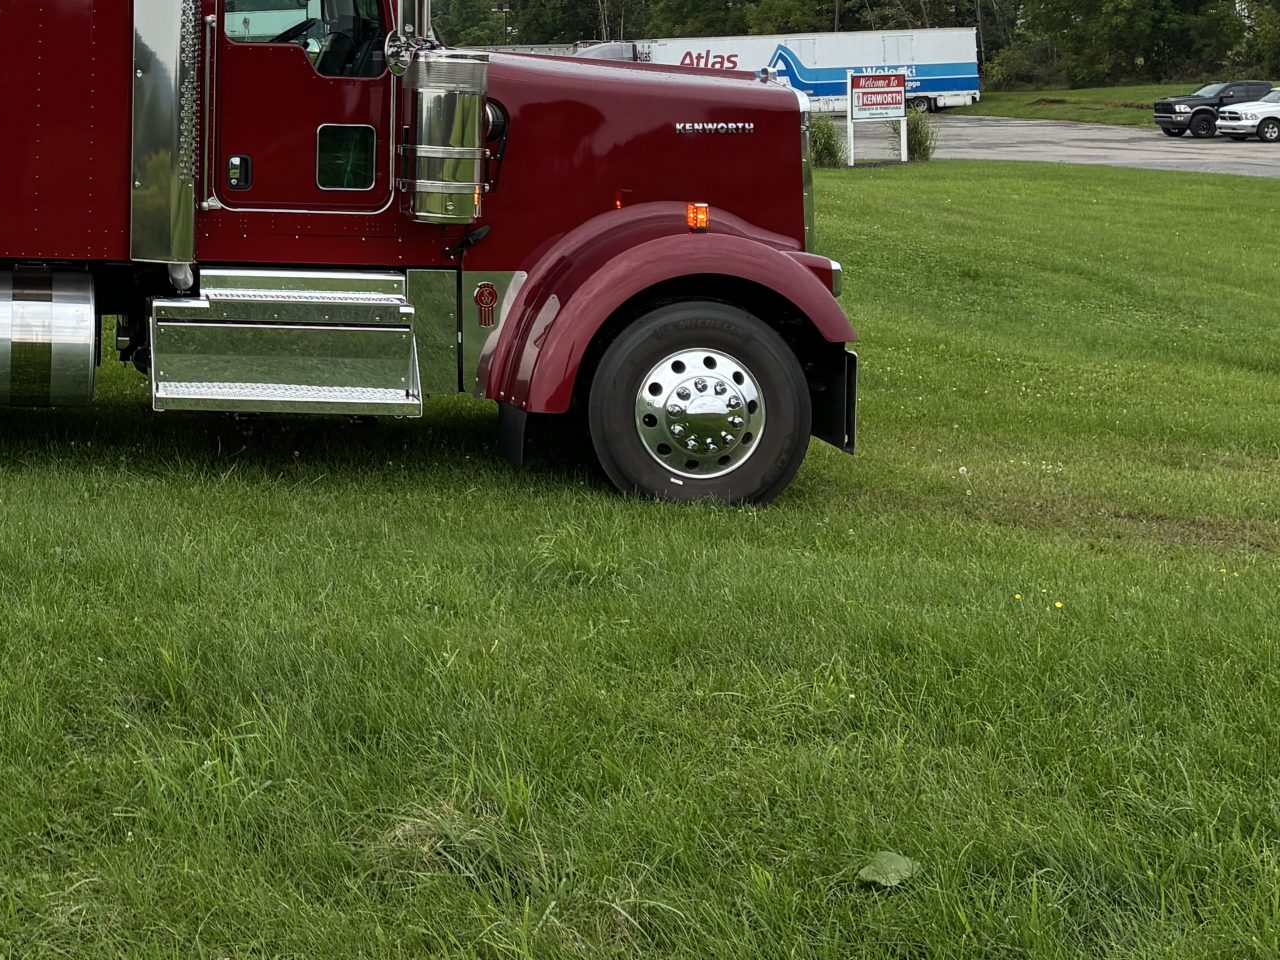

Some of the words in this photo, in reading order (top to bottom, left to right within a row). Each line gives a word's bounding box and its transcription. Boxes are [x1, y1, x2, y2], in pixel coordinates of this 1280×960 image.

[680, 49, 739, 70] Atlas
[859, 77, 889, 88] Welcome
[889, 77, 898, 87] To
[863, 93, 902, 105] KENWORTH
[675, 122, 754, 134] KENWORTH
